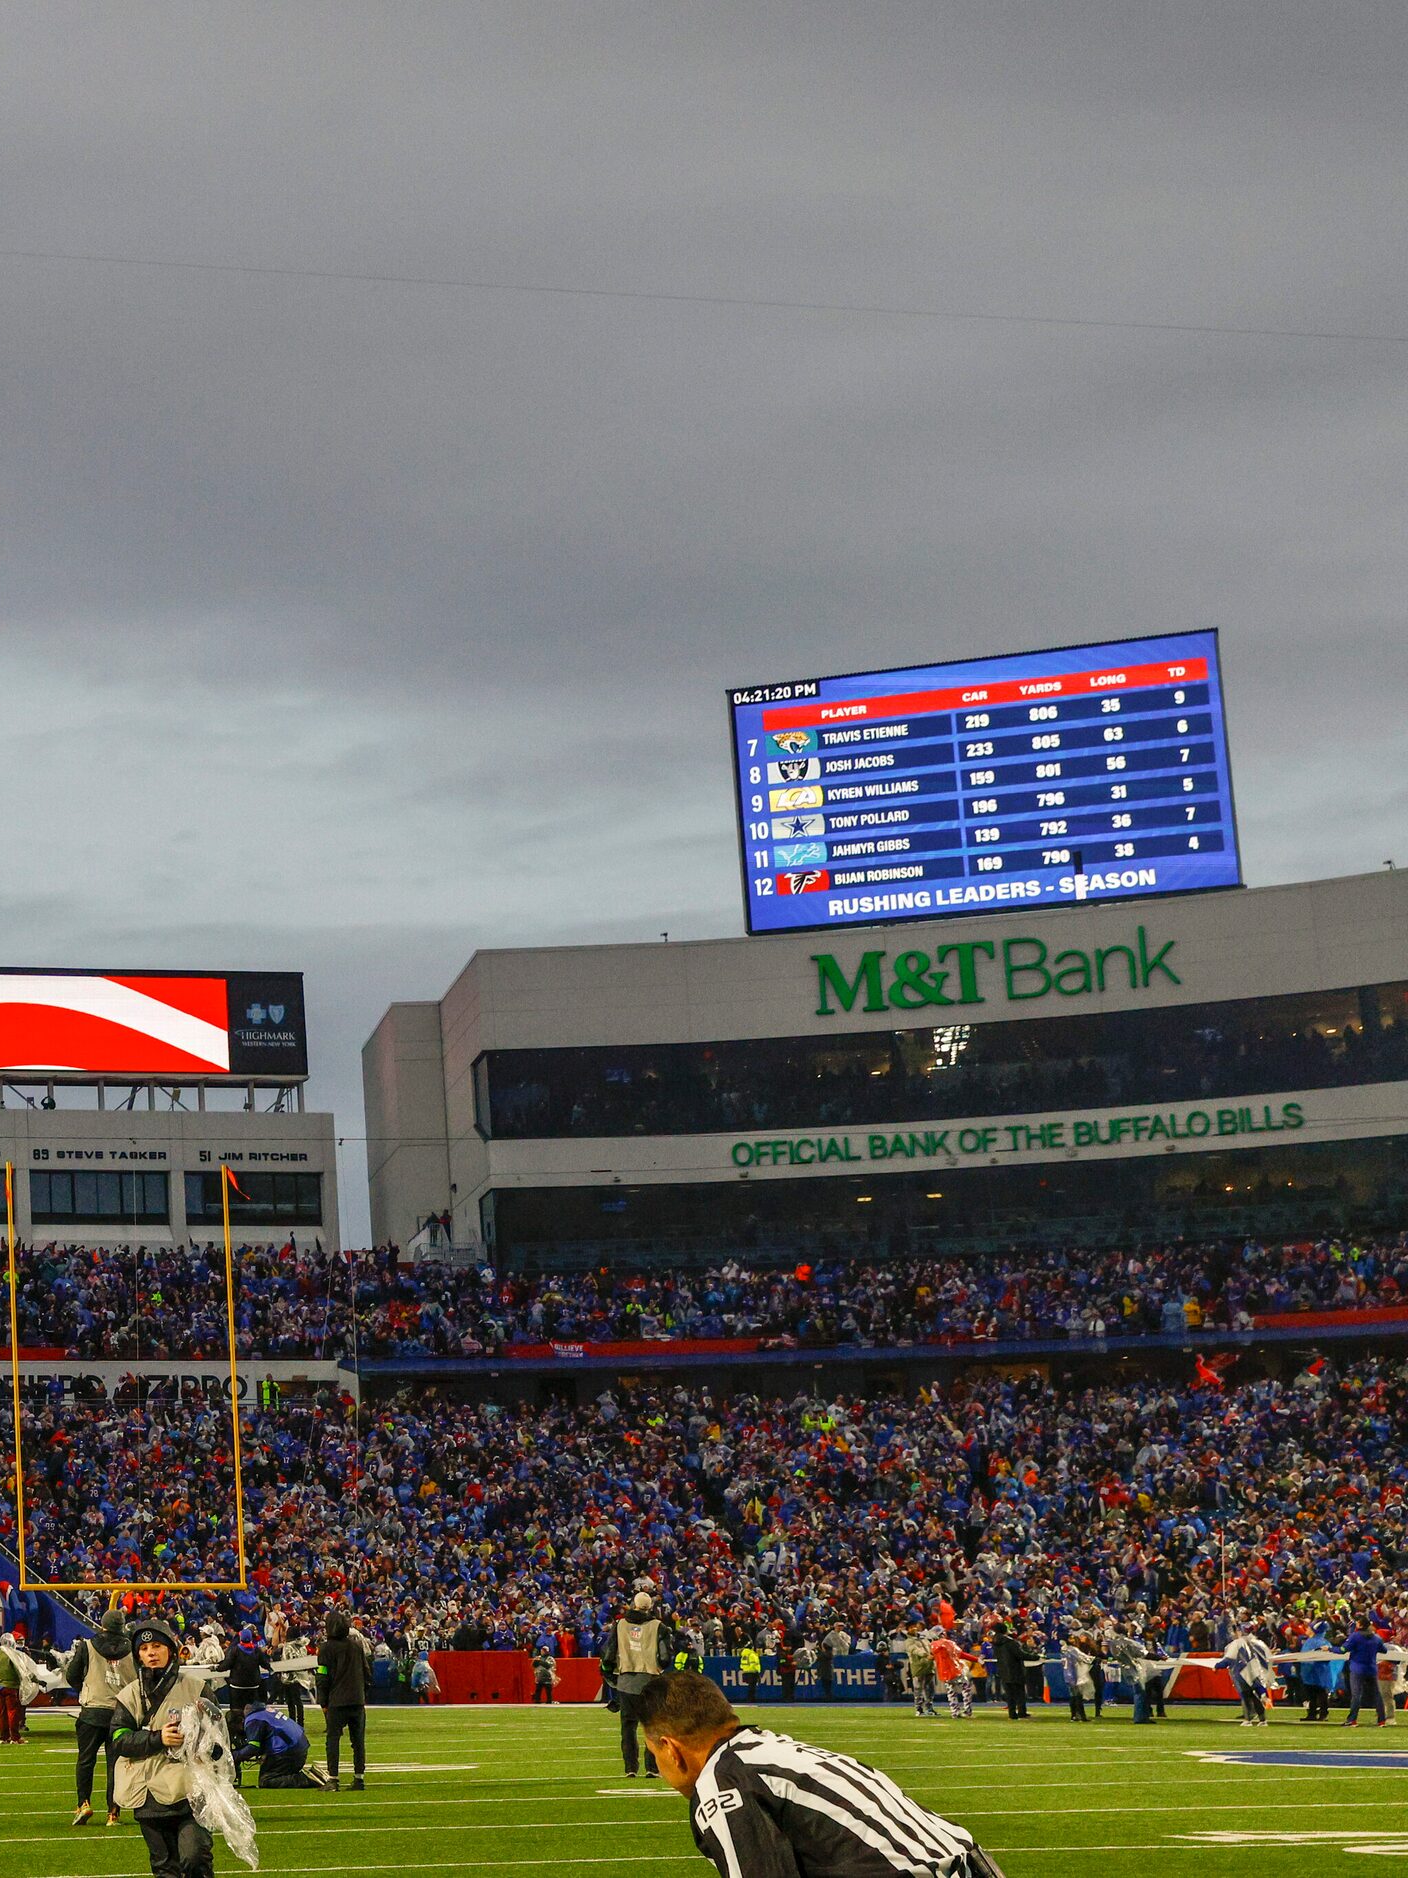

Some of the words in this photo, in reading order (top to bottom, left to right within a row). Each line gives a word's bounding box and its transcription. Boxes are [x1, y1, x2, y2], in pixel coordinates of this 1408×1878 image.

[733, 686, 792, 704] 04:21:20
[794, 683, 817, 697] PM
[821, 705, 867, 719] PLAYER
[961, 690, 988, 702] CAR
[1019, 681, 1062, 696] YARDS
[1090, 674, 1126, 687] LONG
[1167, 666, 1186, 677] TD
[747, 739, 758, 757] 7
[822, 727, 862, 745] TRAVIS
[863, 724, 909, 741] ETIENNE
[965, 714, 990, 728] 219
[1029, 706, 1058, 721] 806
[1101, 698, 1121, 712] 35
[1173, 691, 1185, 704] 9
[749, 766, 761, 784] 8
[825, 757, 853, 773] JOSH
[854, 755, 895, 771] JACOBS
[966, 741, 994, 758] 233
[1031, 734, 1061, 750] 805
[1103, 726, 1124, 741] 63
[1176, 719, 1188, 733] 6
[749, 822, 769, 840] 10
[829, 814, 859, 829] TONY
[860, 810, 910, 826] POLLARD
[972, 799, 997, 814] 196
[1036, 791, 1065, 807] 796
[1110, 784, 1127, 799] 31
[1182, 777, 1193, 791] 5
[751, 795, 763, 812] 9
[827, 785, 864, 801] KYREN
[865, 780, 919, 798] WILLIAMS
[969, 770, 995, 786] 159
[1035, 763, 1062, 779] 801
[1106, 755, 1126, 770] 56
[1180, 748, 1190, 762] 7
[754, 850, 769, 869] 11
[832, 842, 875, 858] JAHMYR
[877, 839, 910, 853] GIBBS
[974, 827, 1000, 842] 139
[1040, 820, 1068, 836] 792
[1111, 813, 1132, 829] 36
[1185, 806, 1196, 820] 7
[754, 878, 774, 897] 12
[834, 869, 865, 886] BIJAN
[866, 865, 923, 882] ROBINSON
[976, 856, 1003, 872] 169
[1042, 849, 1070, 865] 790
[1114, 843, 1135, 857] 38
[1188, 836, 1199, 850] 4
[828, 889, 931, 916] RUSHING
[936, 879, 1041, 907] LEADERS
[810, 941, 995, 1016] M&T
[1003, 925, 1181, 1001] Bank
[32, 1149, 49, 1160] 89
[56, 1150, 104, 1160] STEVE
[109, 1151, 167, 1160] TASKER
[199, 1150, 211, 1162] 51
[218, 1152, 243, 1161] JIM
[249, 1152, 308, 1162] RITCHER
[731, 1134, 861, 1167] OFFICIAL
[869, 1128, 952, 1159] BANK
[957, 1127, 997, 1154] OF
[1003, 1121, 1067, 1151] THE
[1074, 1110, 1210, 1148] BUFFALO
[1216, 1103, 1305, 1136] BILLS
[833, 1668, 877, 1685] THE
[698, 1793, 736, 1823] 132
